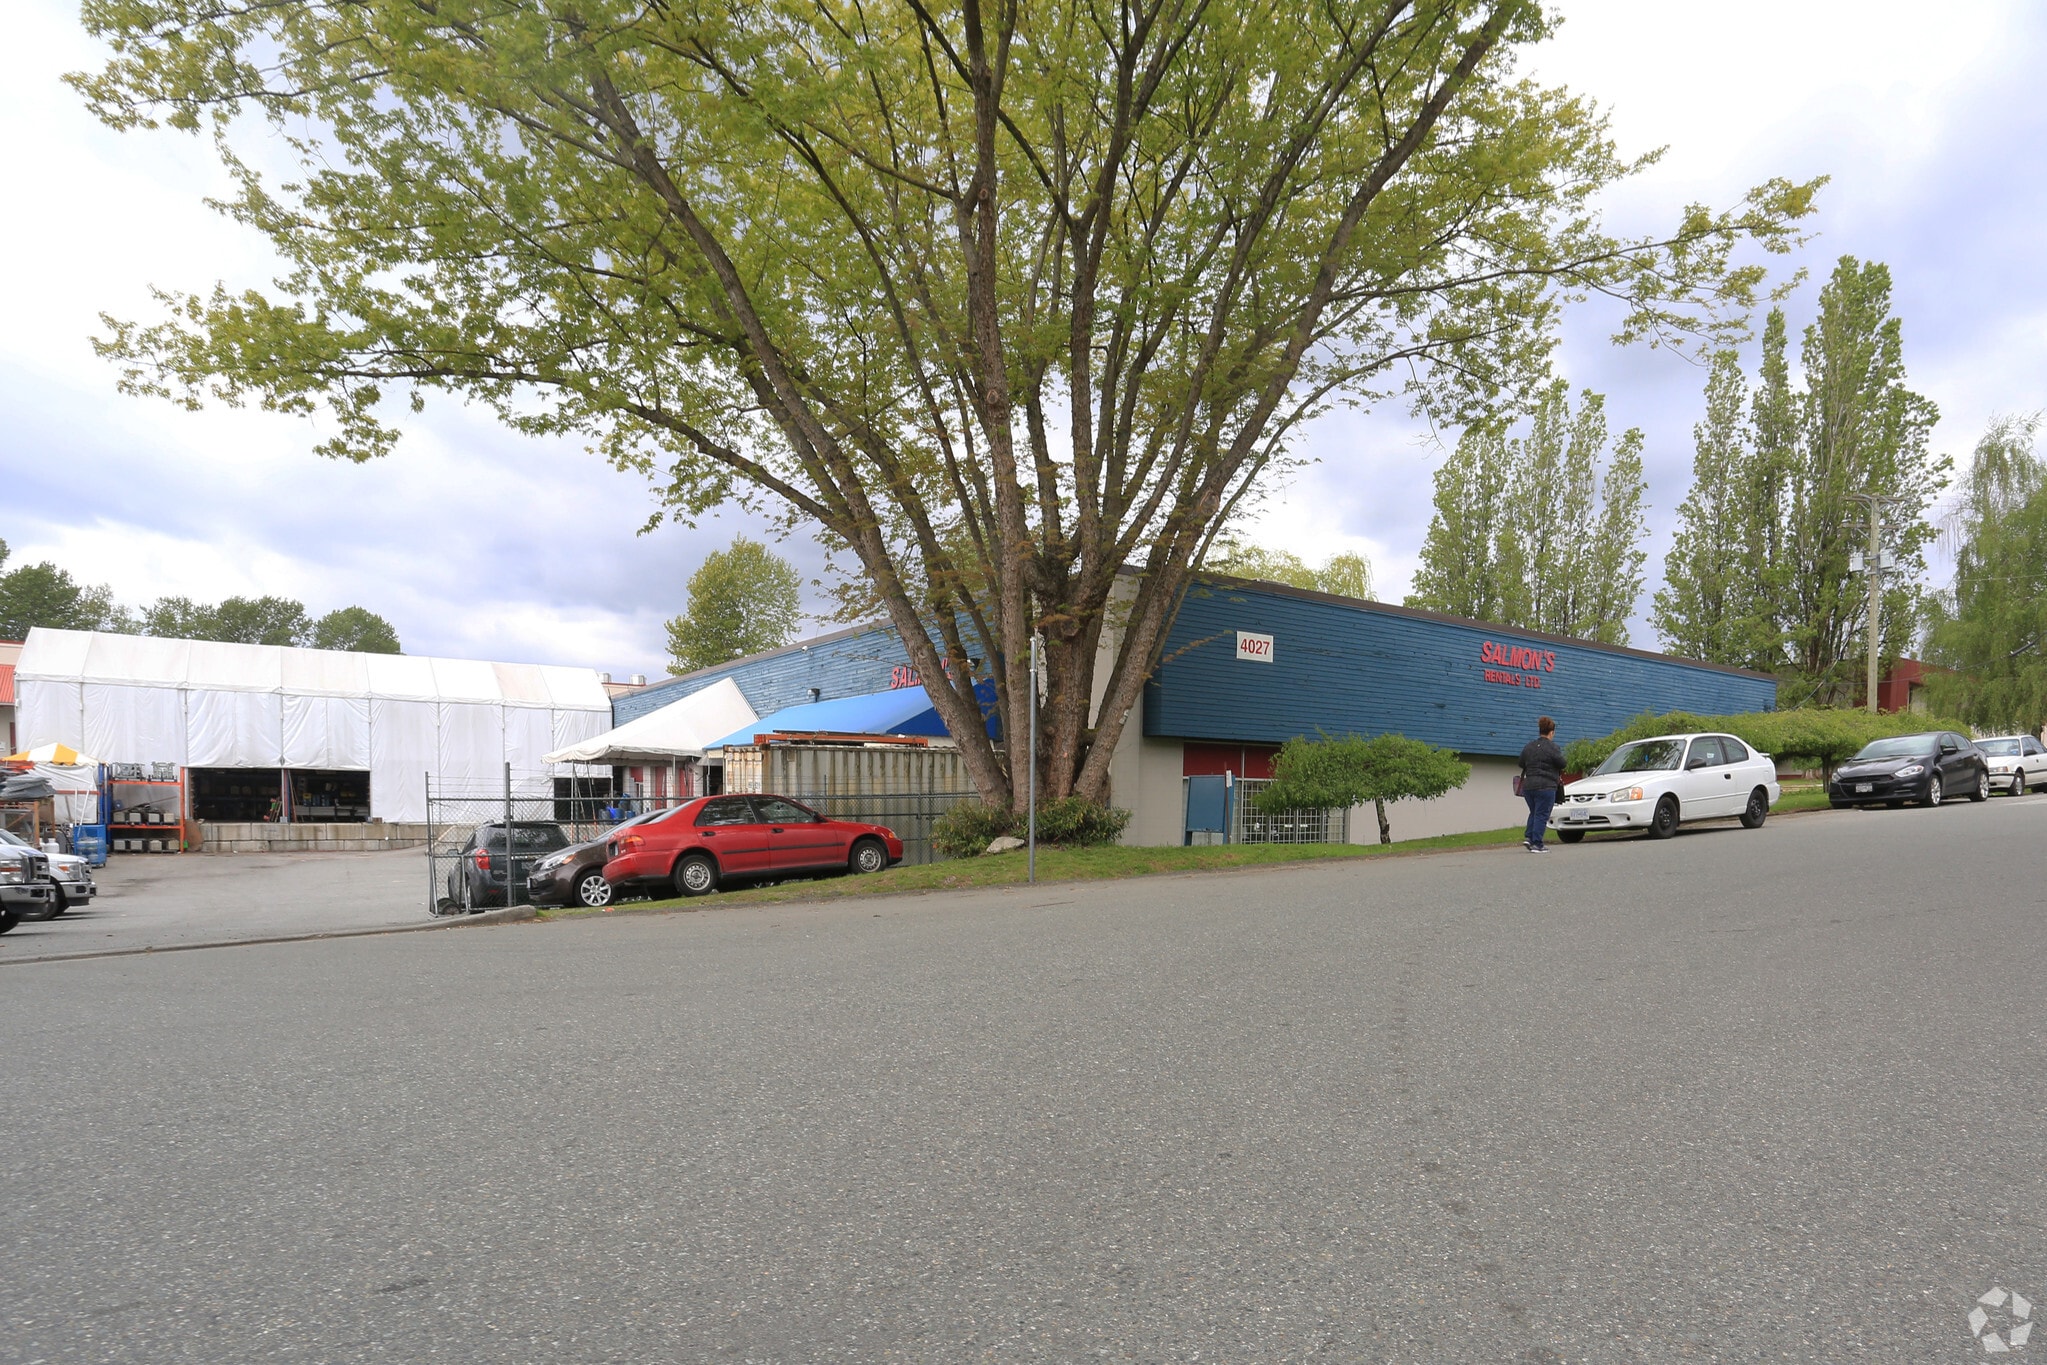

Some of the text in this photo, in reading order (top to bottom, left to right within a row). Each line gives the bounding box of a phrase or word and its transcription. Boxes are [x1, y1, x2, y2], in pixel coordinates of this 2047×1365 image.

[1240, 638, 1270, 655] 4027
[1480, 640, 1556, 673] SALMON'S
[1484, 669, 1521, 686] RENTALS
